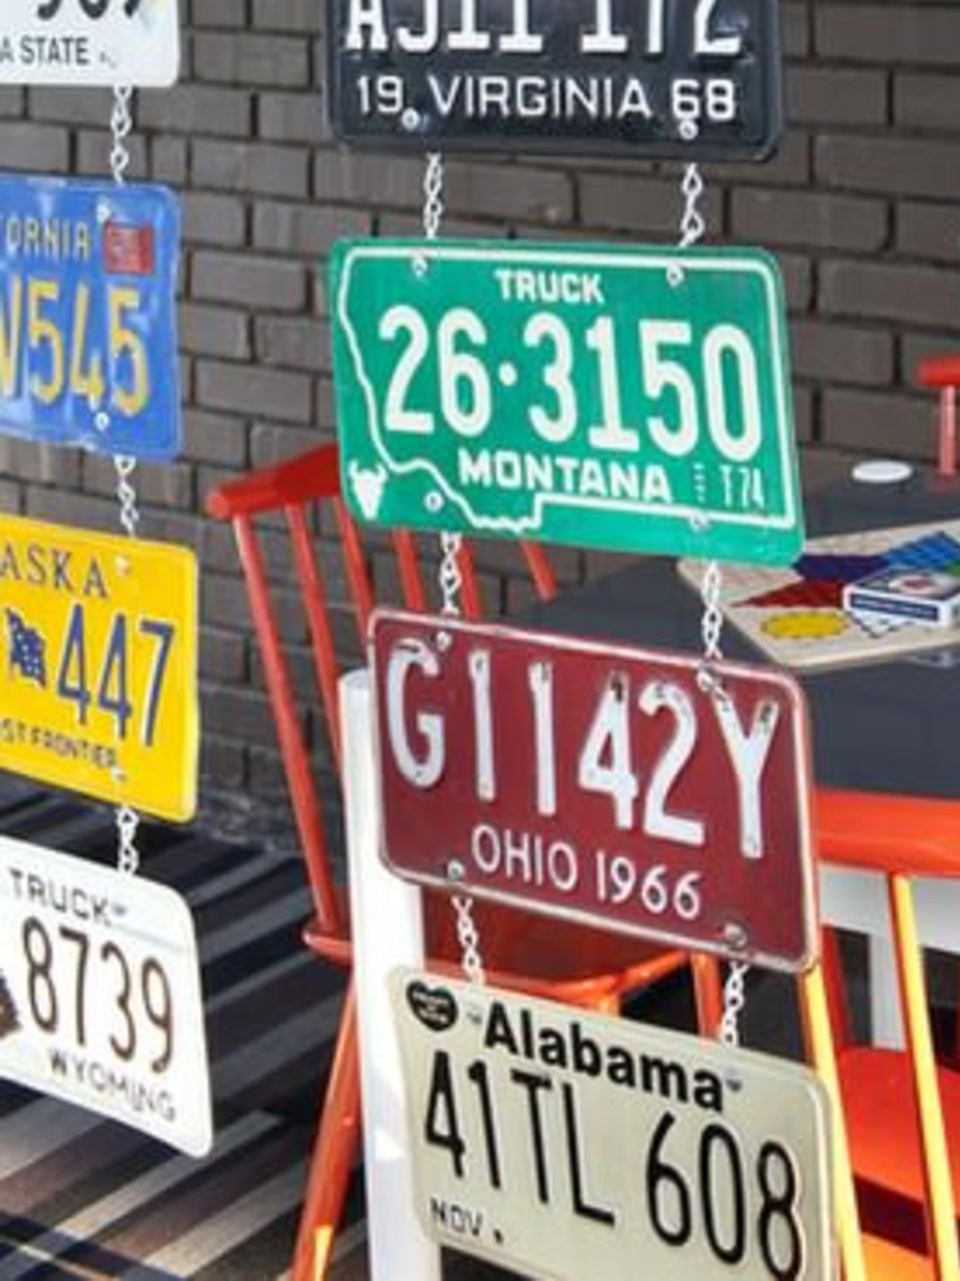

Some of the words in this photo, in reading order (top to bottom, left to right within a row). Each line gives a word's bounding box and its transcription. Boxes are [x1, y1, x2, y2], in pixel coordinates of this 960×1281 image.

[20, 35, 90, 66] STATE
[357, 74, 404, 115] 19
[429, 75, 652, 119] VIRGINIA
[672, 77, 735, 121] 68
[6, 217, 90, 262] ORNIA
[494, 268, 604, 304] TRUCK
[458, 448, 673, 503] MONTANA
[0, 543, 108, 599] ASKA
[57, 603, 174, 746] 447
[387, 638, 779, 859] G1142Y
[10, 869, 111, 928] TRUCK
[472, 824, 578, 891] OHIO
[596, 849, 702, 919] 1966
[23, 916, 173, 1073] 8739
[50, 1049, 176, 1122] WYOMING
[485, 1001, 724, 1112] Alabama
[425, 1050, 617, 1228] 41TL
[646, 1112, 802, 1281] 608
[430, 1197, 483, 1237] NOV
